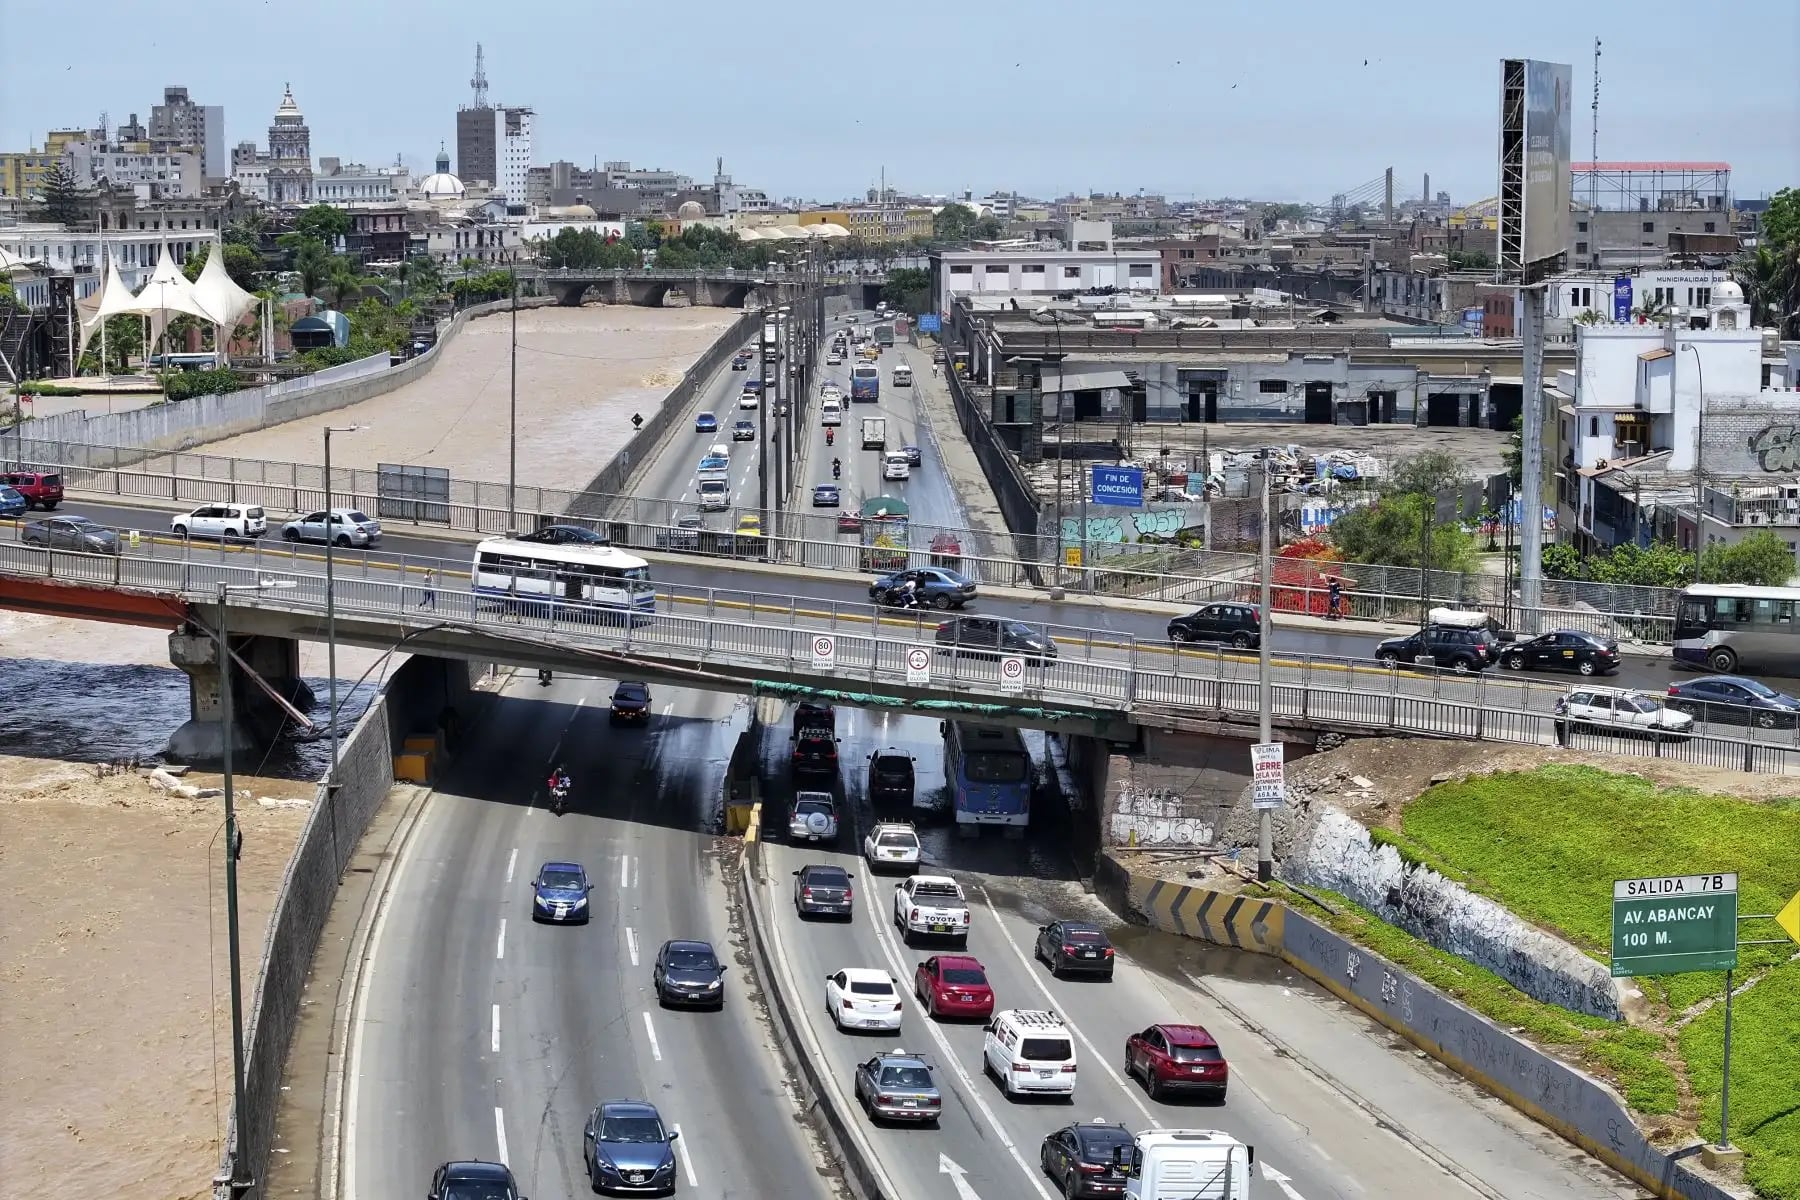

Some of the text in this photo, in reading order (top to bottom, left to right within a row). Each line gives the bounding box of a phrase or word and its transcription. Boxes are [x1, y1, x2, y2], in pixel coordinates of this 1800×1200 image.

[1105, 473, 1130, 483] FIN DE
[1096, 482, 1138, 495] CONCESIÓN
[818, 641, 829, 650] 80
[1007, 663, 1018, 672] 80
[1255, 761, 1281, 771] CIERRE
[1627, 875, 1723, 895] SALIDA 7B
[924, 915, 957, 923] TOYOTA
[1623, 905, 1715, 924] AV. ABANCAY
[1622, 931, 1672, 946] 100 M.
